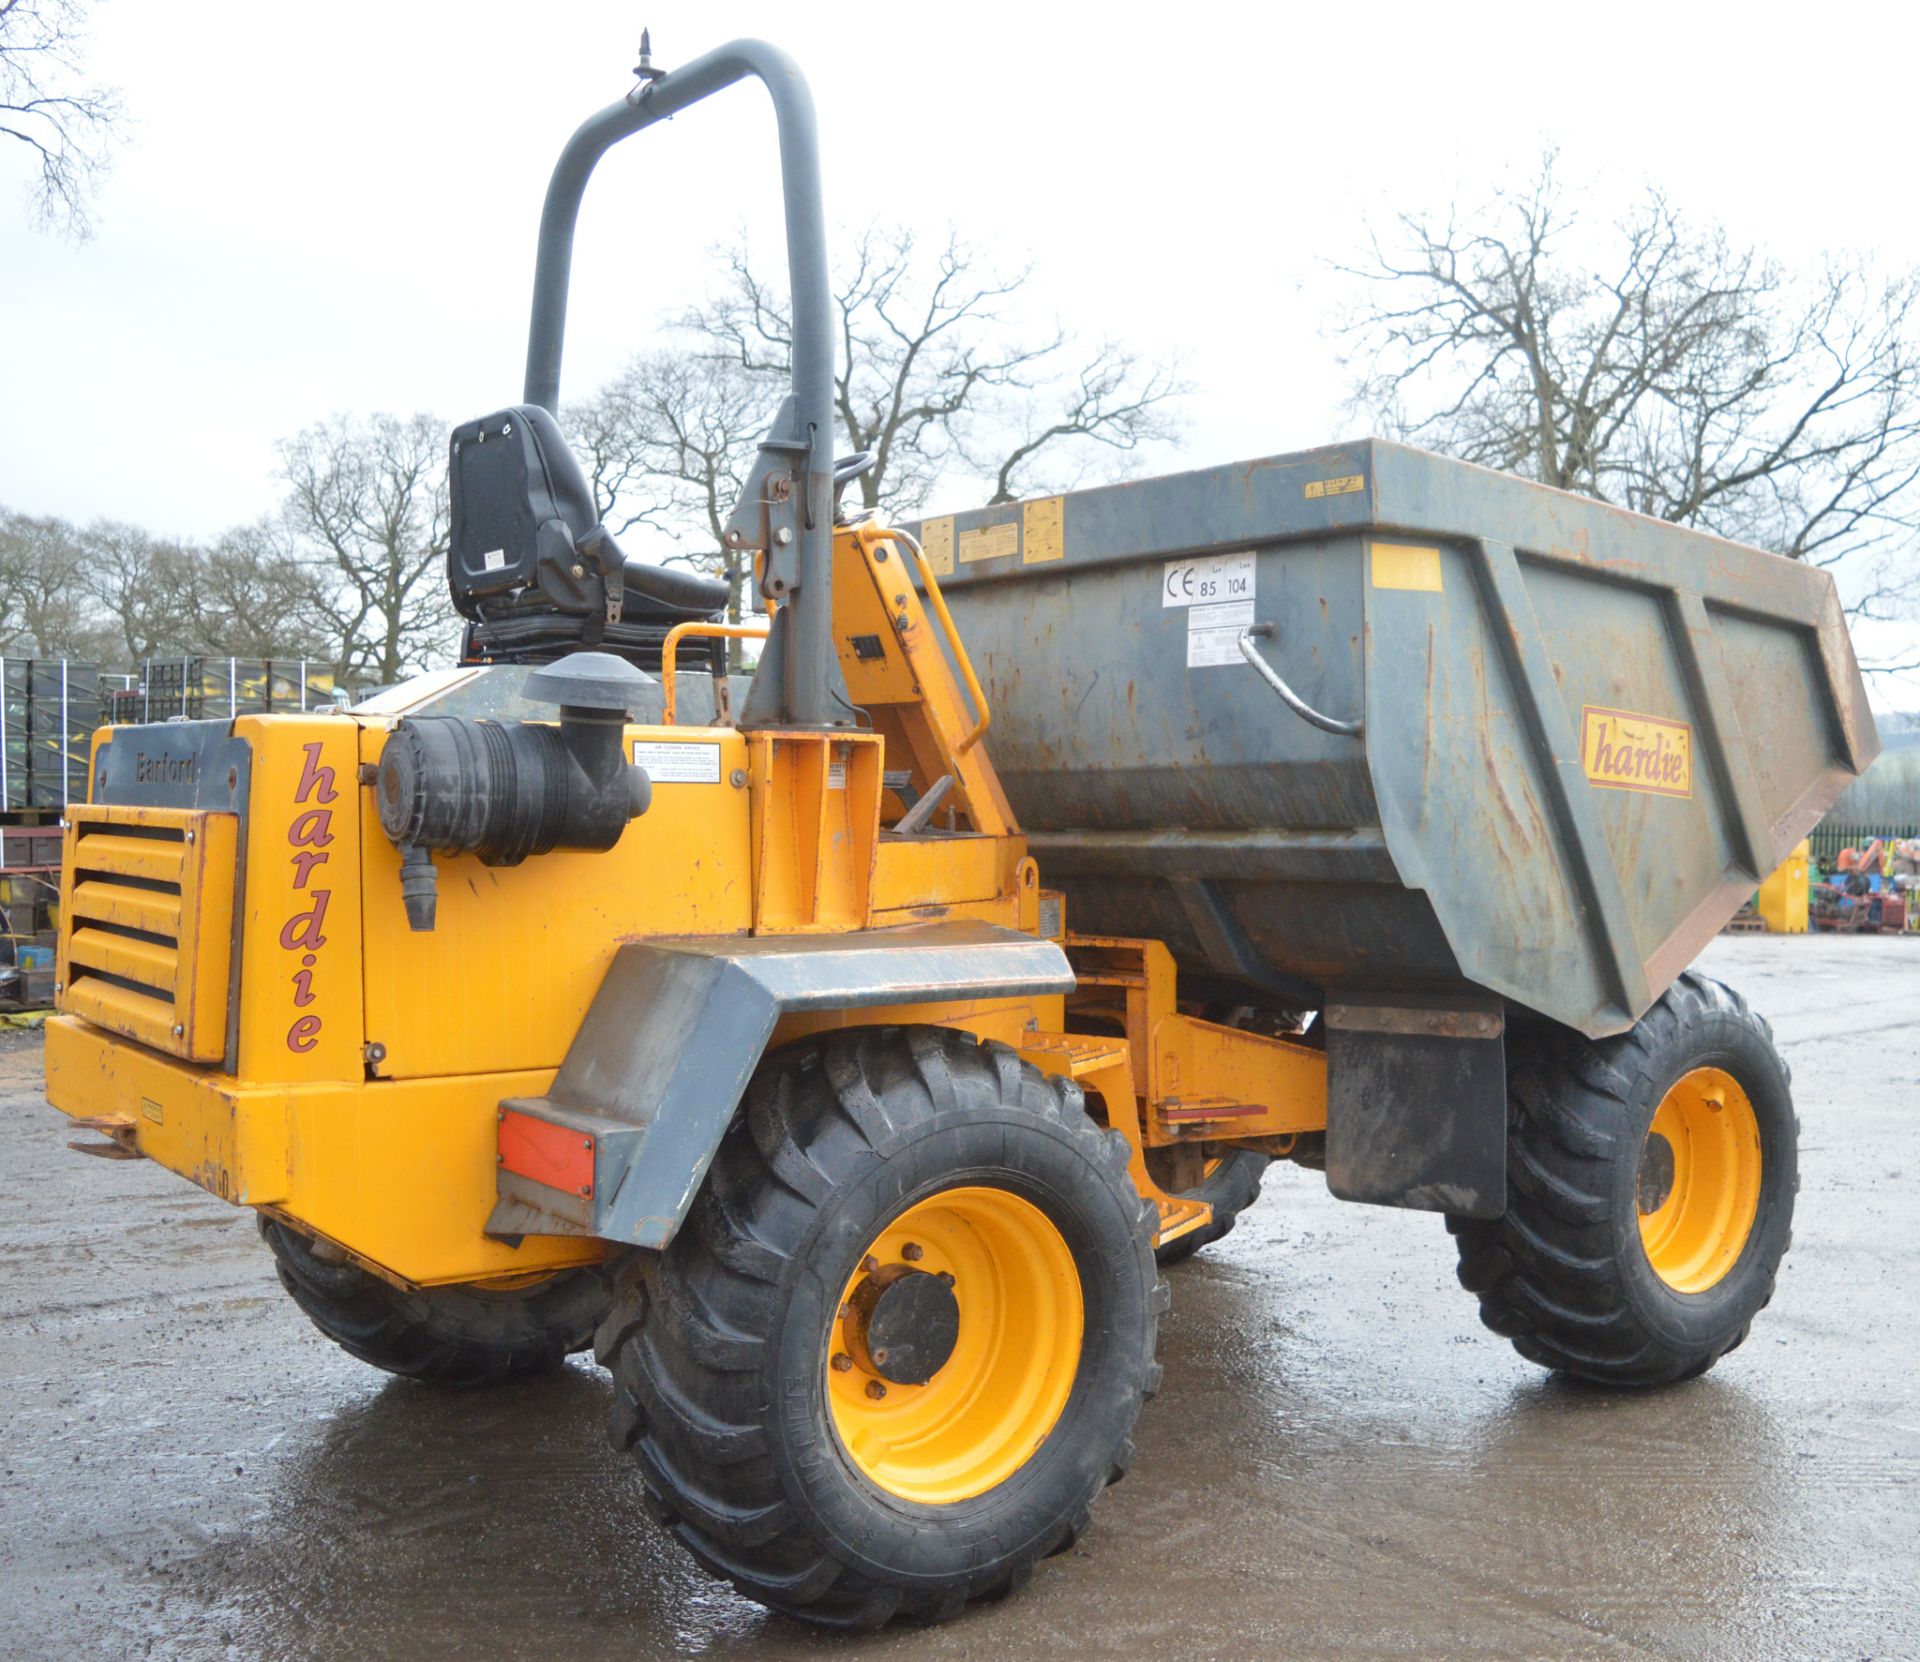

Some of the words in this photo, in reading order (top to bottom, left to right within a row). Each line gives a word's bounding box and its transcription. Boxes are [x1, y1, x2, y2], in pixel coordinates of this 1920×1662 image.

[1200, 581, 1217, 597] 85
[1228, 578, 1247, 595] 104
[136, 751, 196, 784] Barford
[1593, 722, 1683, 783] hardie
[279, 742, 339, 1054] hardie
